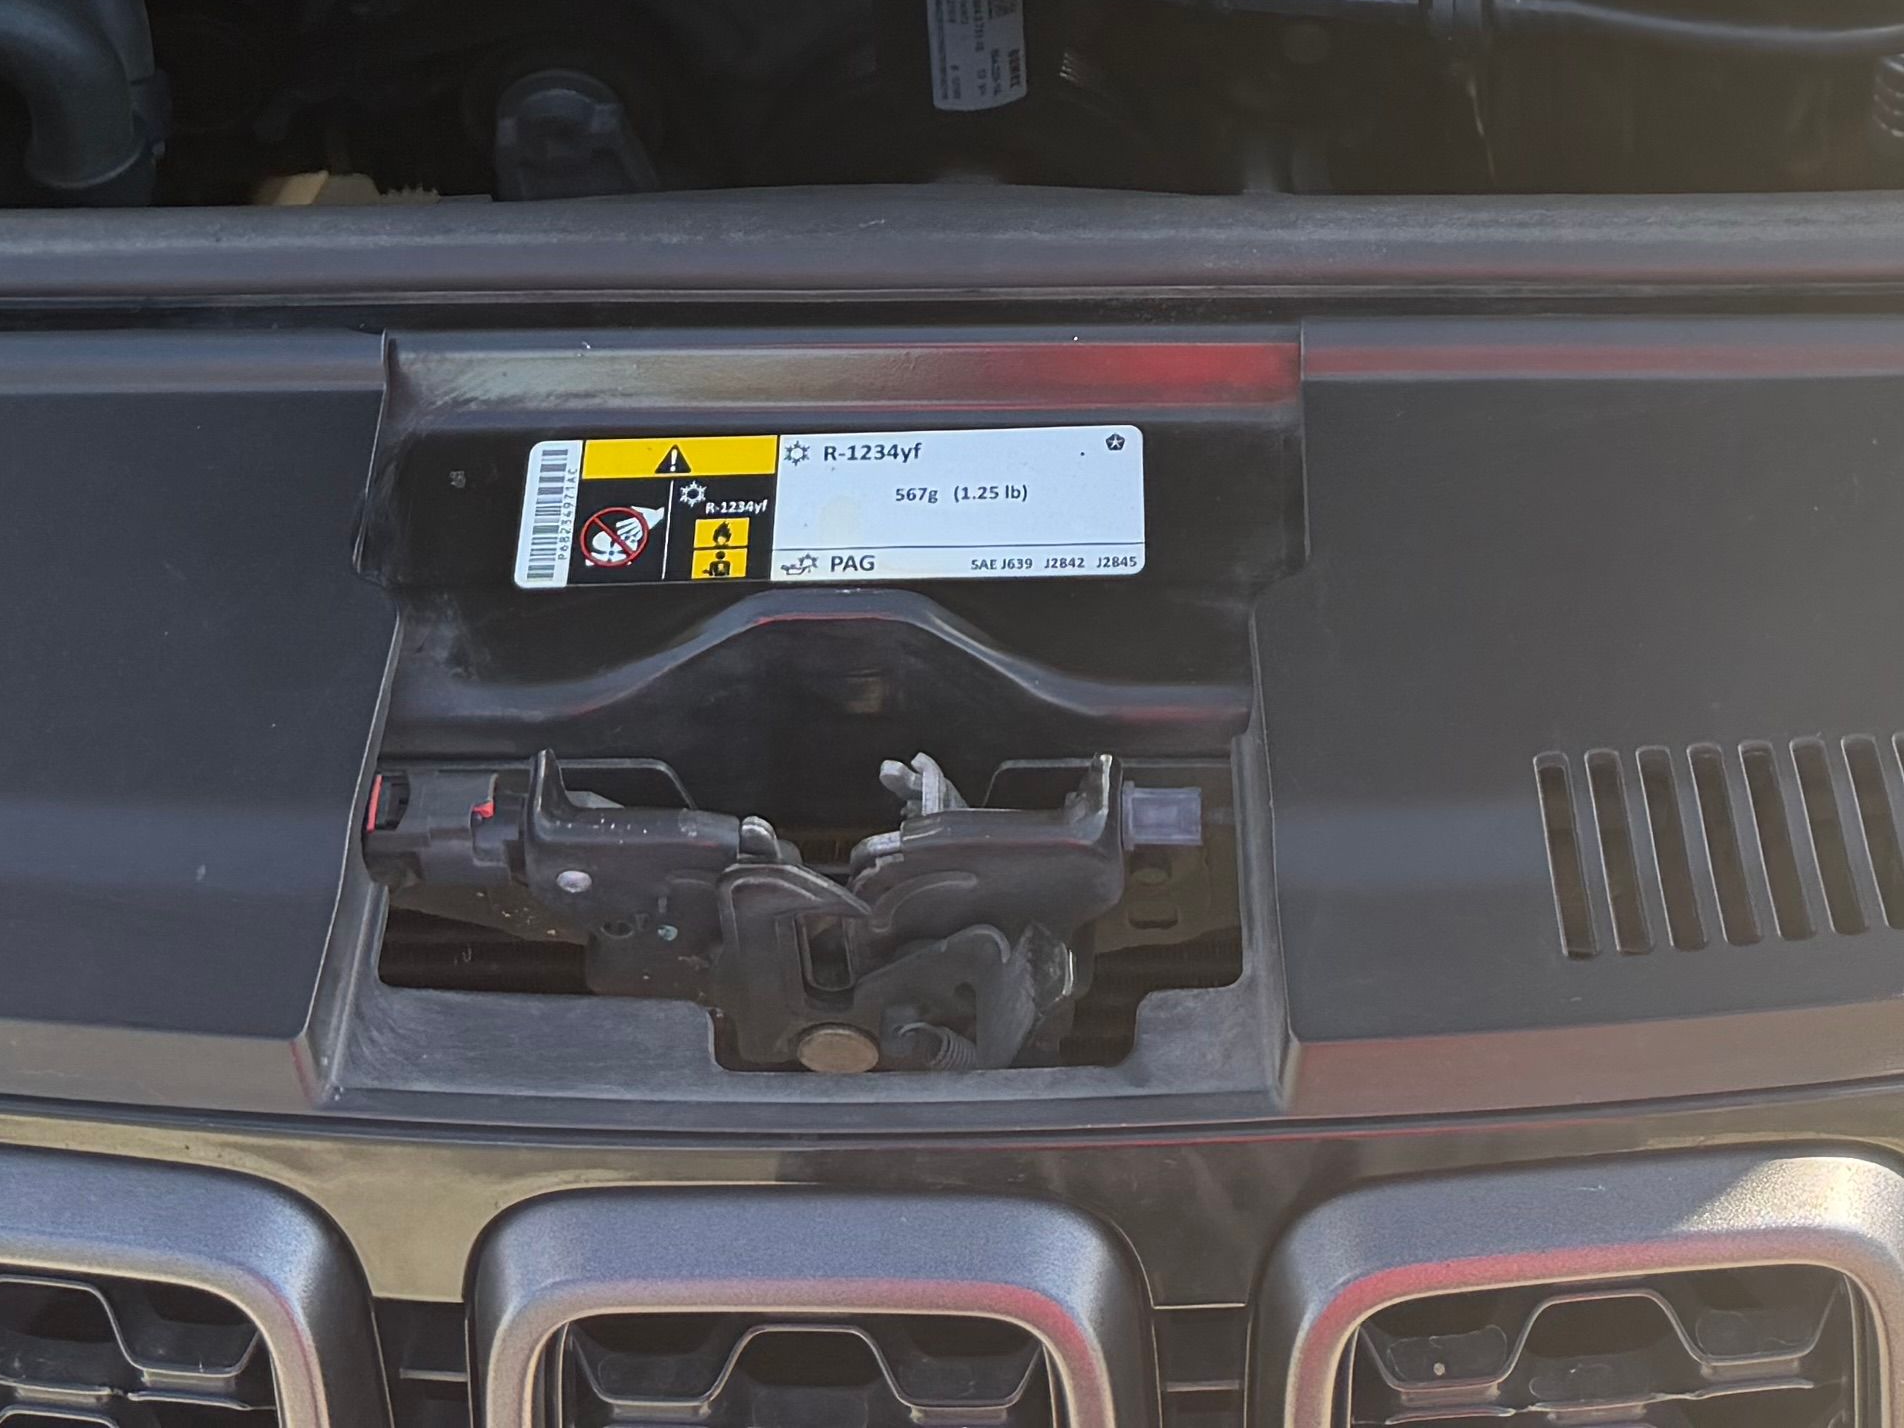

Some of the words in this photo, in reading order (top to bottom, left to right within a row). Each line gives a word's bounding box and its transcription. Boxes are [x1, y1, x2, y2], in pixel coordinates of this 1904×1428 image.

[823, 442, 922, 463] R-1234yf
[895, 487, 938, 504] 567g
[953, 485, 1000, 503] (1.25
[1005, 484, 1029, 502] lb)
[705, 498, 769, 515] R-1234yf
[830, 555, 876, 573] PAG
[970, 559, 996, 570] SAE
[1001, 558, 1033, 570] J639
[1044, 557, 1086, 569] J2842
[1096, 556, 1138, 569] J2845
